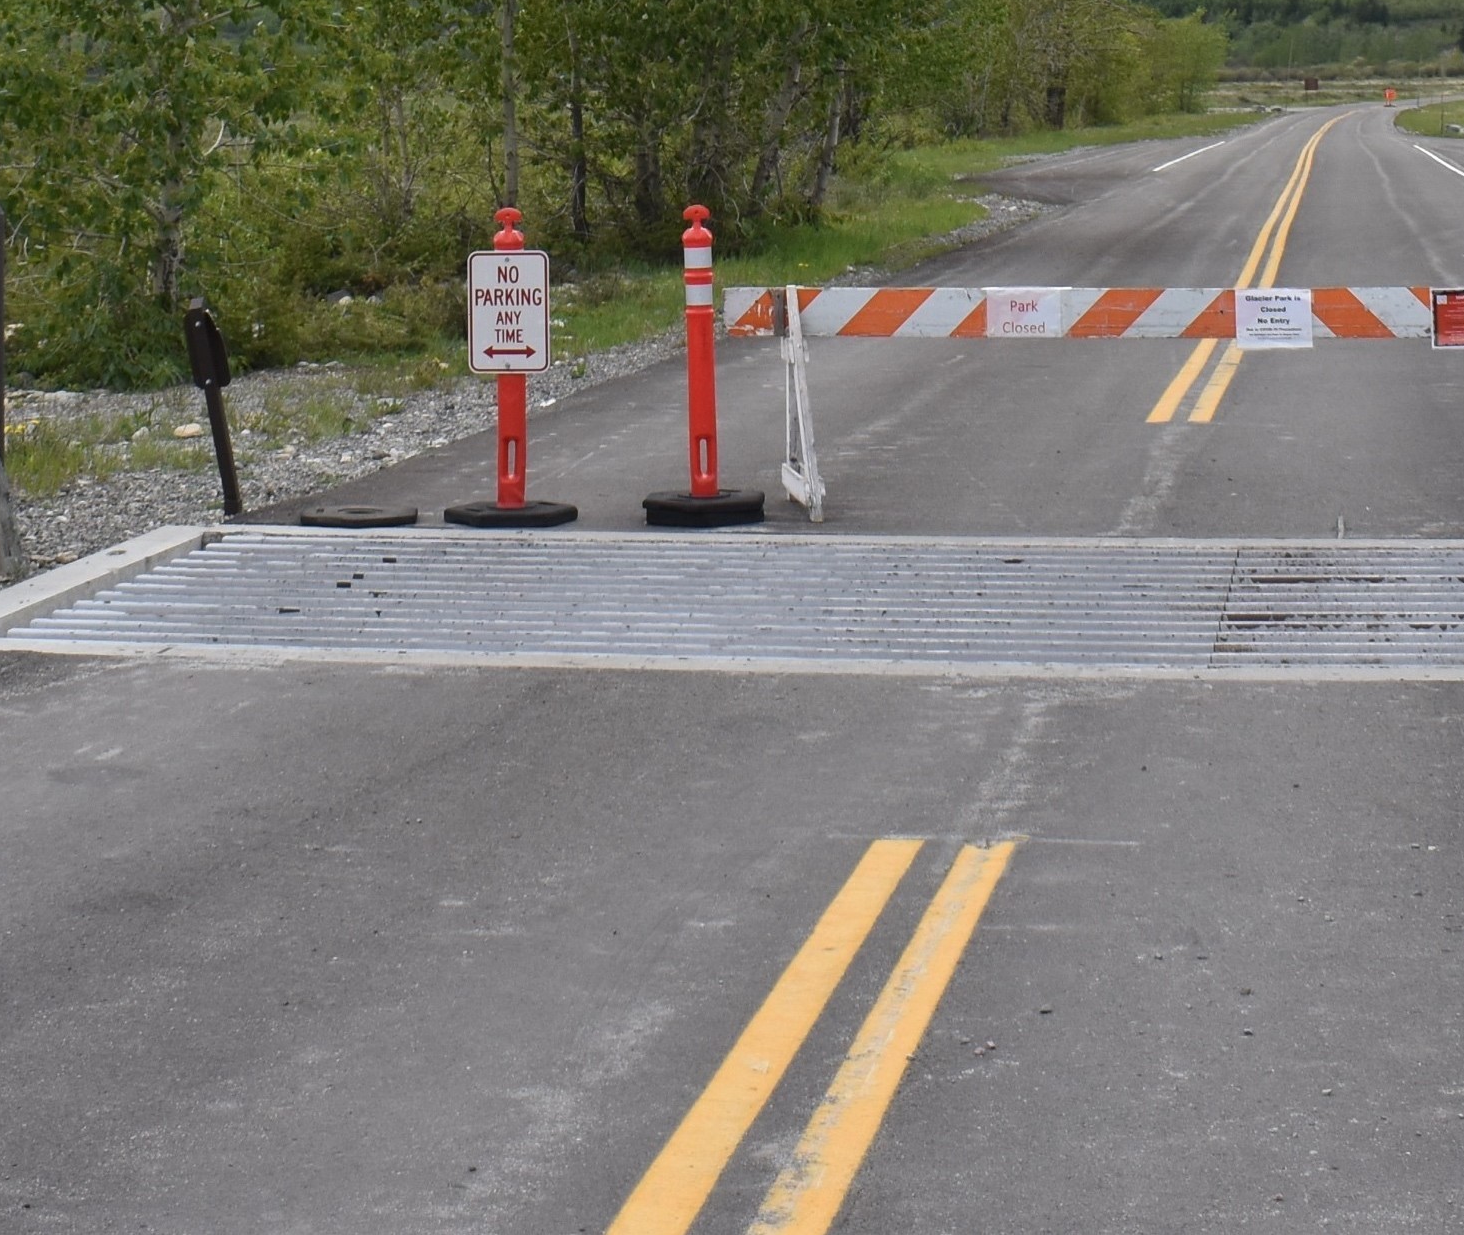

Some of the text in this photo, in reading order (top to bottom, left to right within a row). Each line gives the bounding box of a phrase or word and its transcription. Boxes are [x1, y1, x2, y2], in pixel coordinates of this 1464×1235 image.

[497, 265, 519, 283] NO
[475, 288, 542, 306] PARKING
[1010, 299, 1038, 312] Park
[496, 311, 522, 325] ANY
[1270, 317, 1290, 325] Entry
[1002, 321, 1046, 334] Closed
[495, 329, 524, 343] TIME
